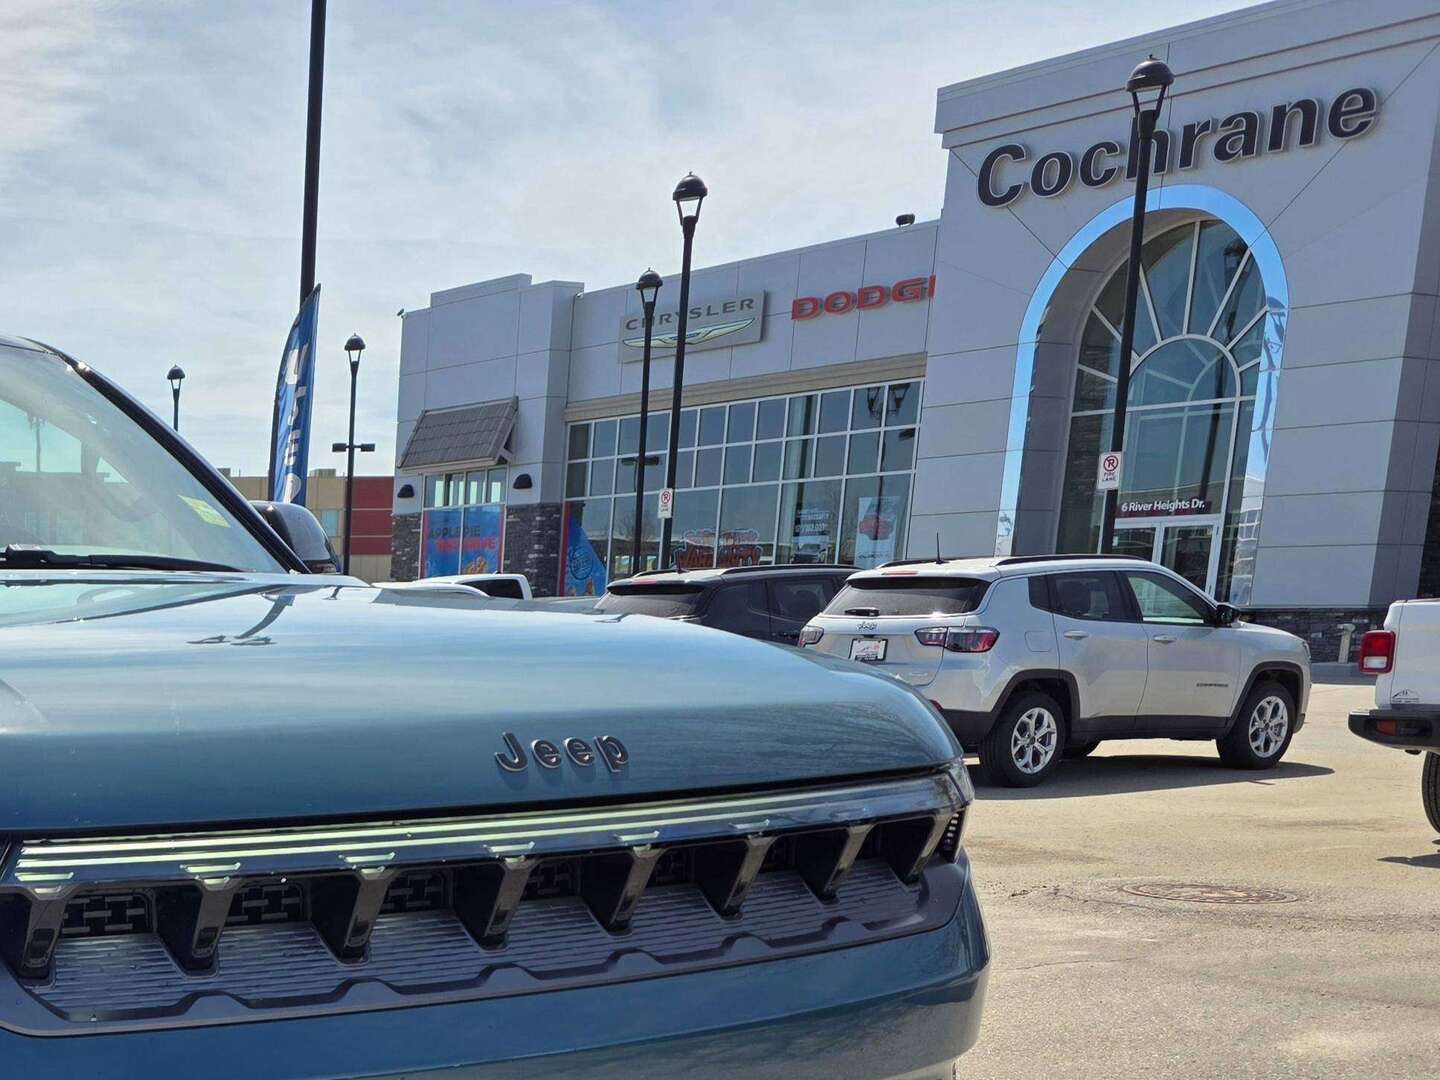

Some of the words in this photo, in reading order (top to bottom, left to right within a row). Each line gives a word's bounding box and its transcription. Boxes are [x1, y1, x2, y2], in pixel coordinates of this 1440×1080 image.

[977, 86, 1379, 208] Cochrane
[1121, 502, 1128, 512] 6
[1129, 501, 1152, 511] River
[1153, 499, 1190, 512] Heights
[1191, 498, 1205, 508] Dr.
[494, 731, 629, 773] Jeep
